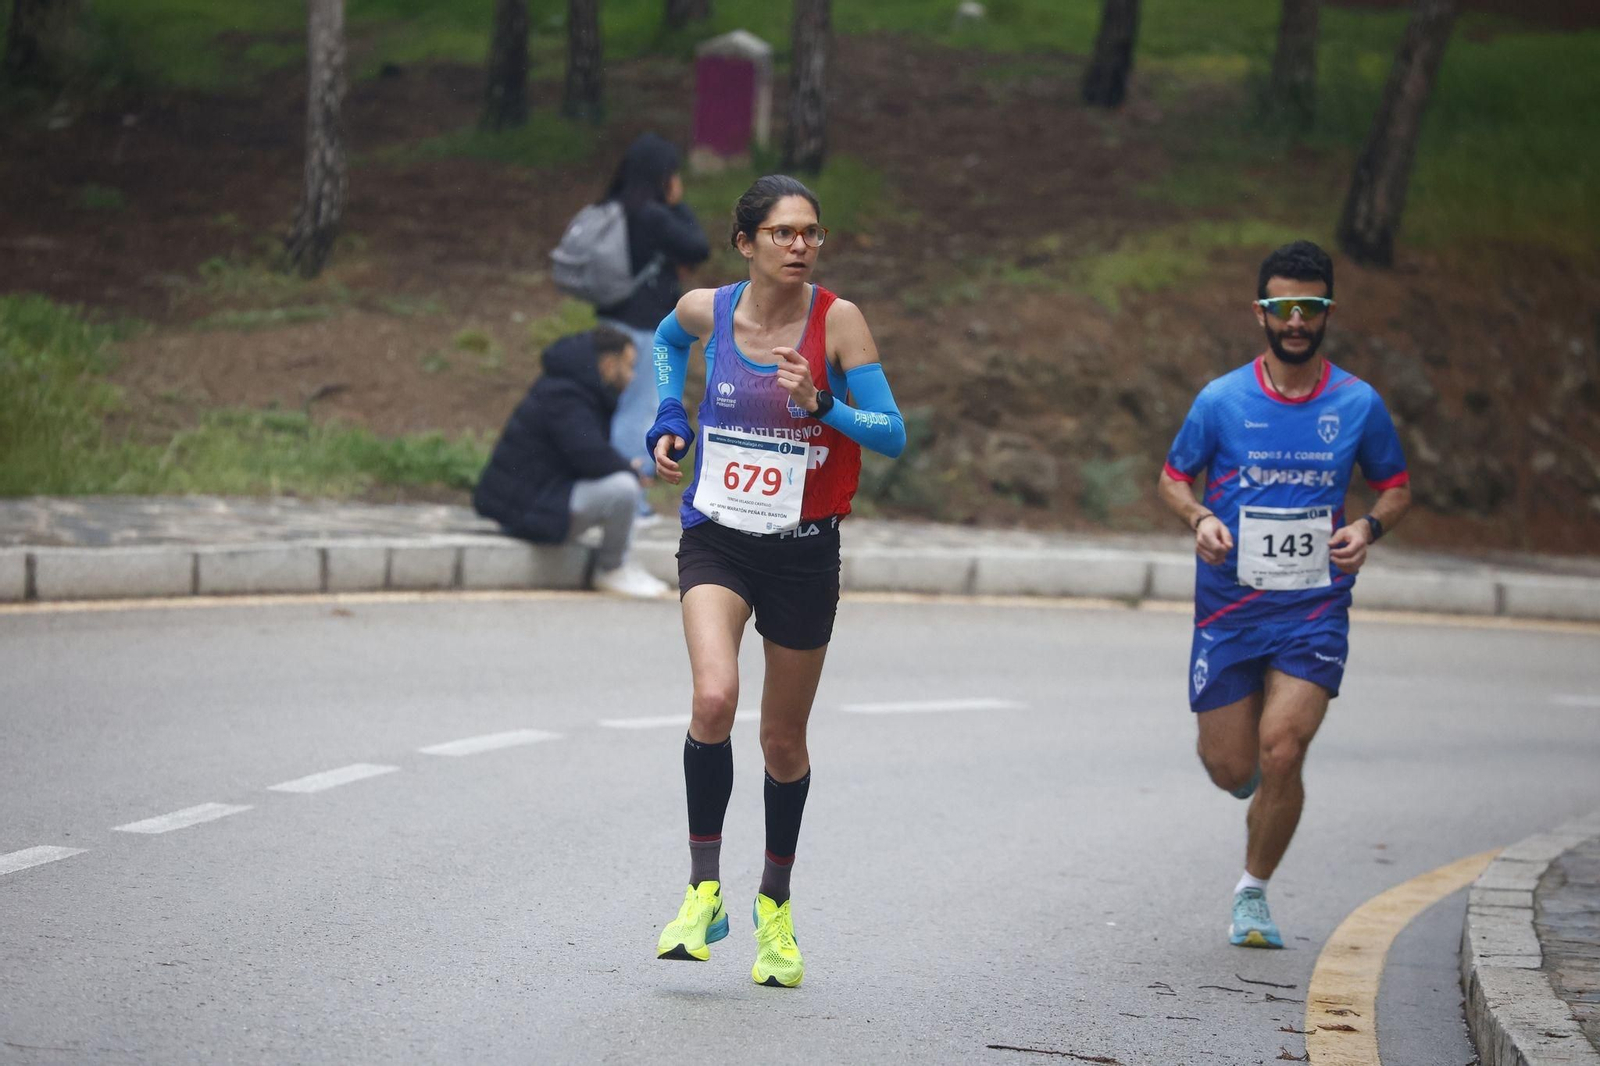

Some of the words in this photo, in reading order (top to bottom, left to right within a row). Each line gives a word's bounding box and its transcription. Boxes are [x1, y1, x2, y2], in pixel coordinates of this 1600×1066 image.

[653, 346, 672, 387] Longfield
[1294, 452, 1334, 460] CORRER
[724, 462, 782, 496] 679
[780, 524, 820, 540] FILA
[1262, 533, 1314, 558] 143
